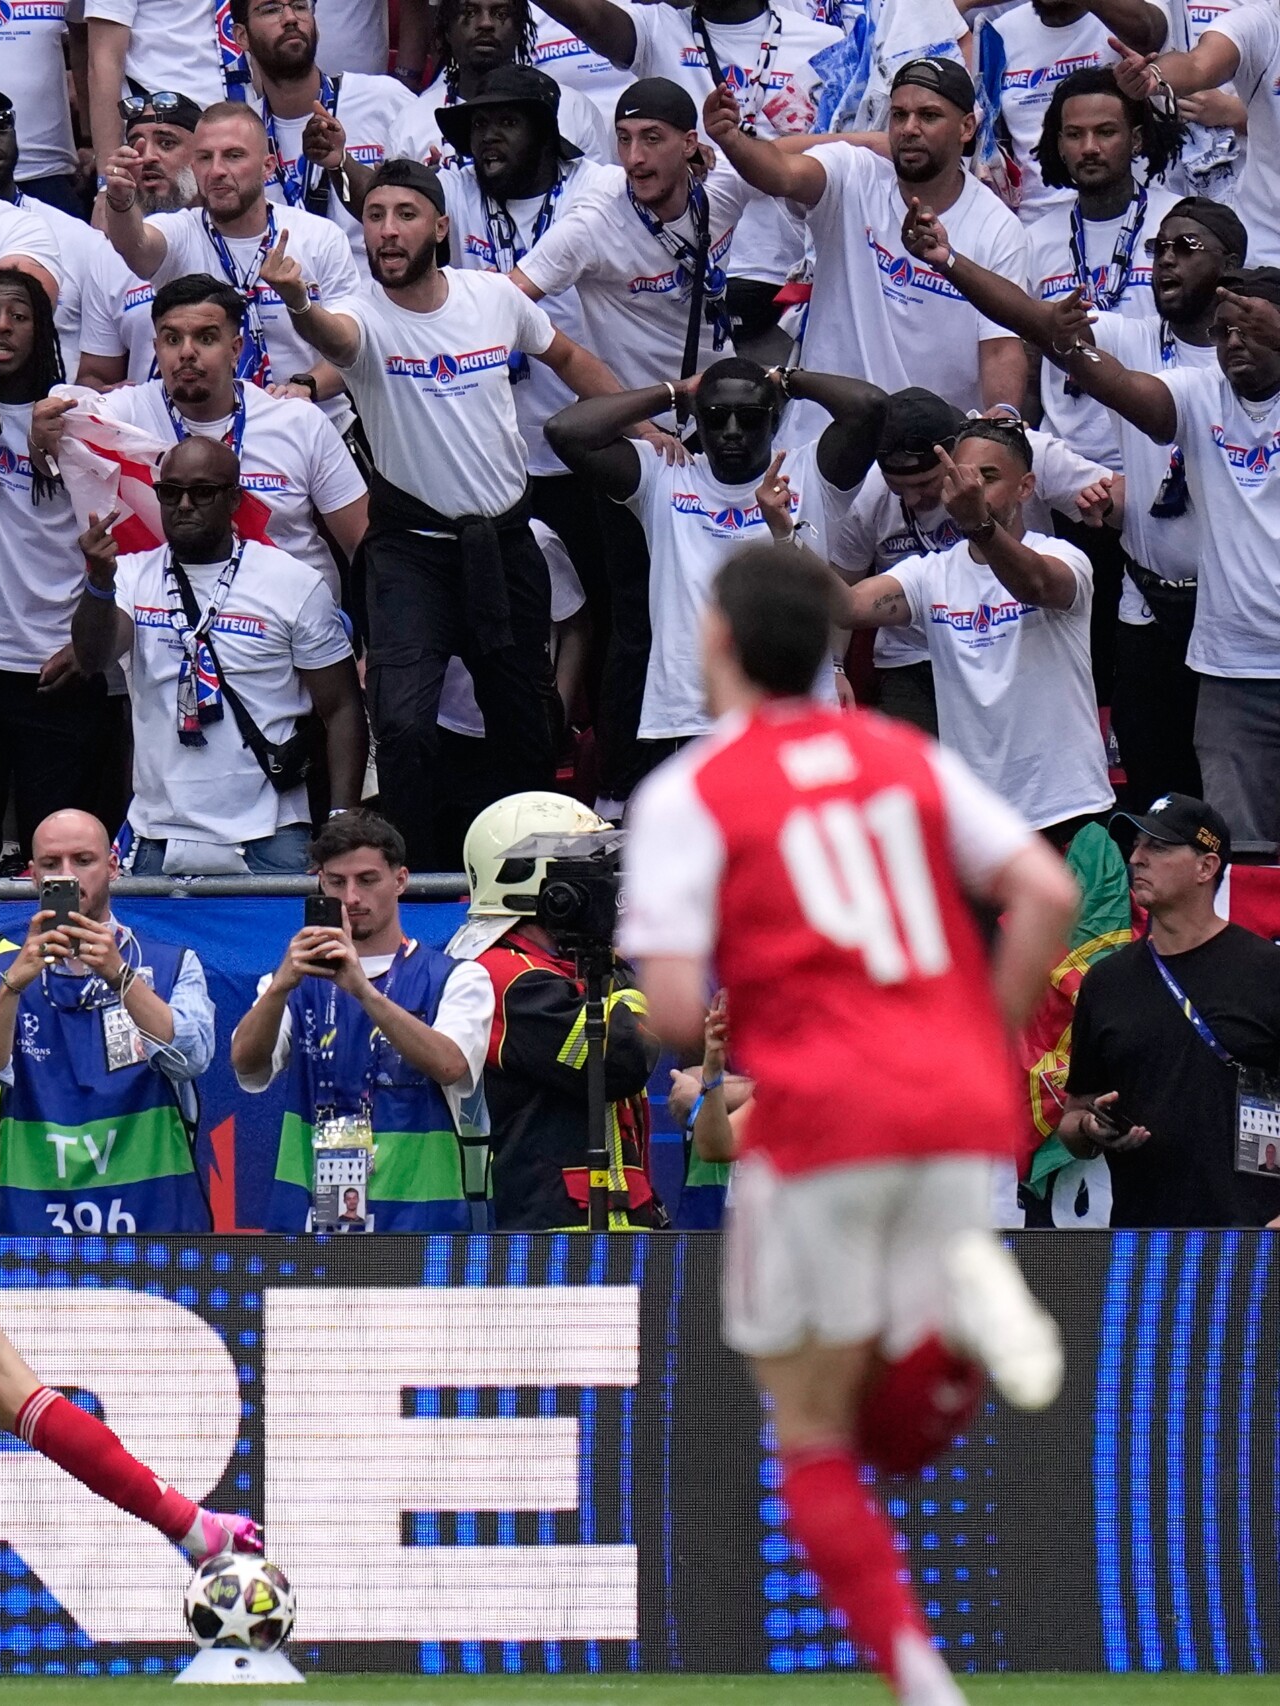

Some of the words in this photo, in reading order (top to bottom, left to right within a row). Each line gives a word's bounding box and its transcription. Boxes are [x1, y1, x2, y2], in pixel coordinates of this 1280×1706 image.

[15, 4, 65, 17] AUTEUIL
[536, 40, 588, 62] VIRAGE
[914, 271, 963, 296] AUTEU
[461, 349, 507, 371] AUTEUIL
[239, 475, 284, 489] UTEUIL
[782, 788, 952, 986] 41
[46, 1129, 117, 1179] TV
[46, 1199, 136, 1233] 396
